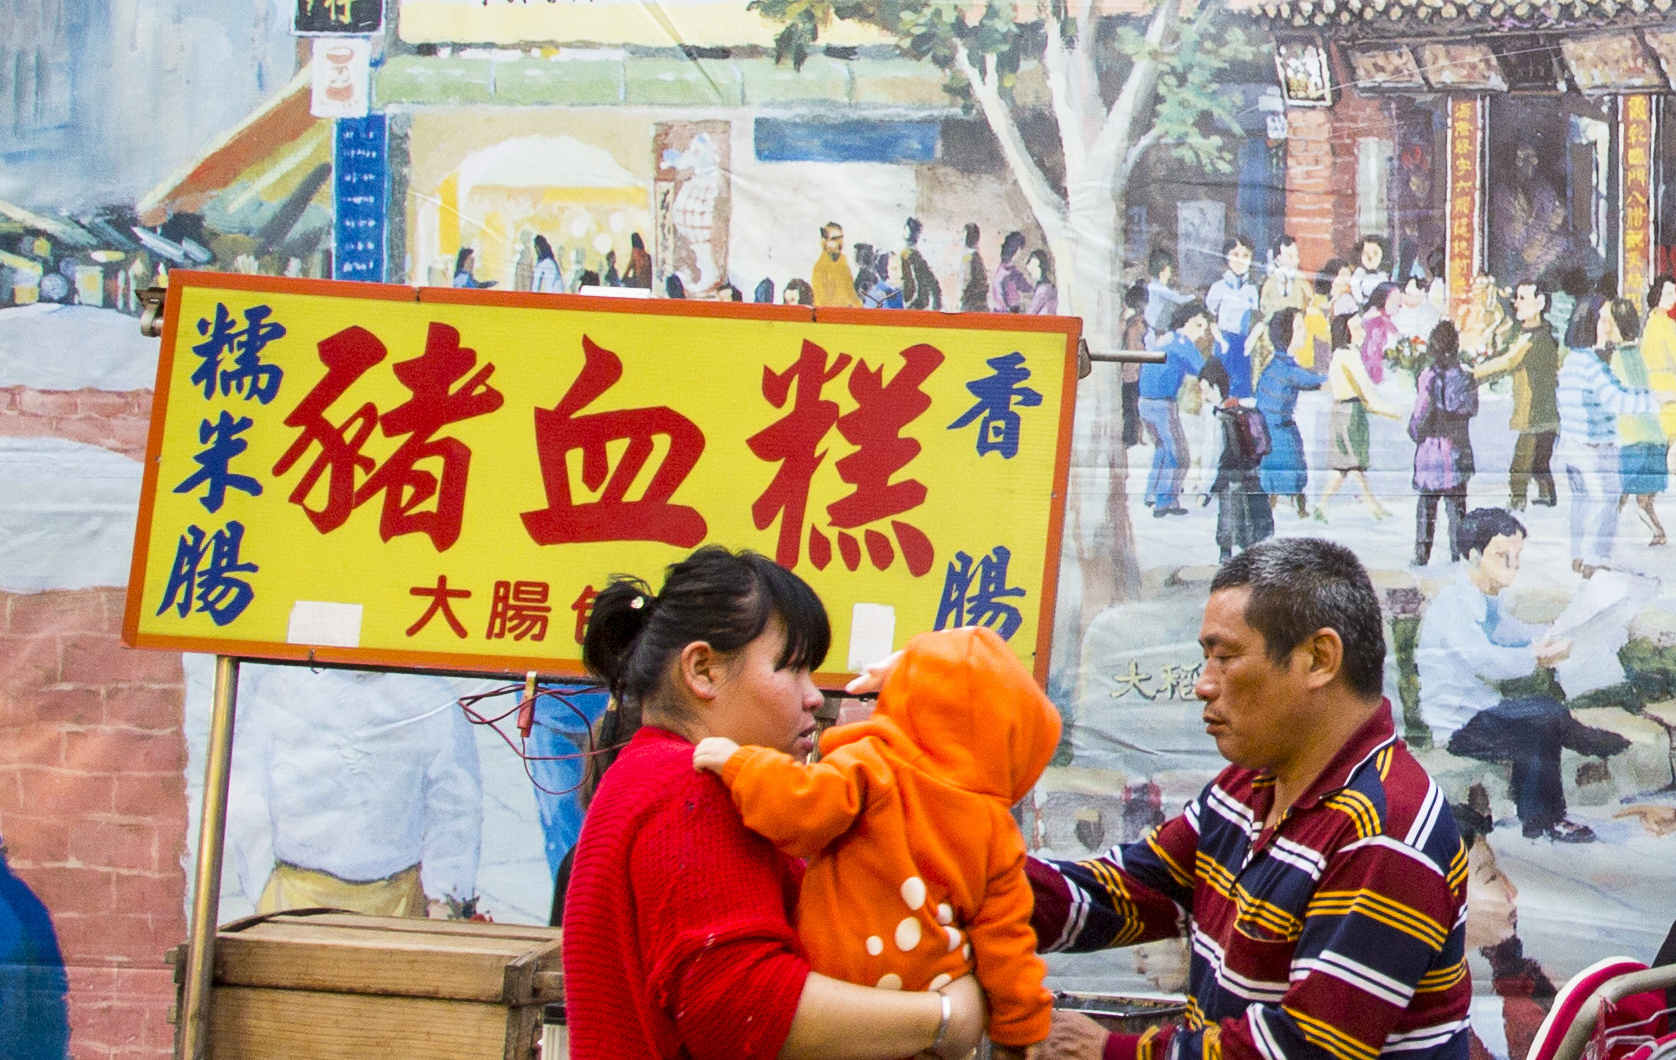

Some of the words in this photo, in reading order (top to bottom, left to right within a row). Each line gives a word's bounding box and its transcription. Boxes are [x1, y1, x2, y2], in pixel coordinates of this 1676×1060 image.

[157, 302, 287, 627] 糯米腸
[271, 321, 946, 578] 豬血糕
